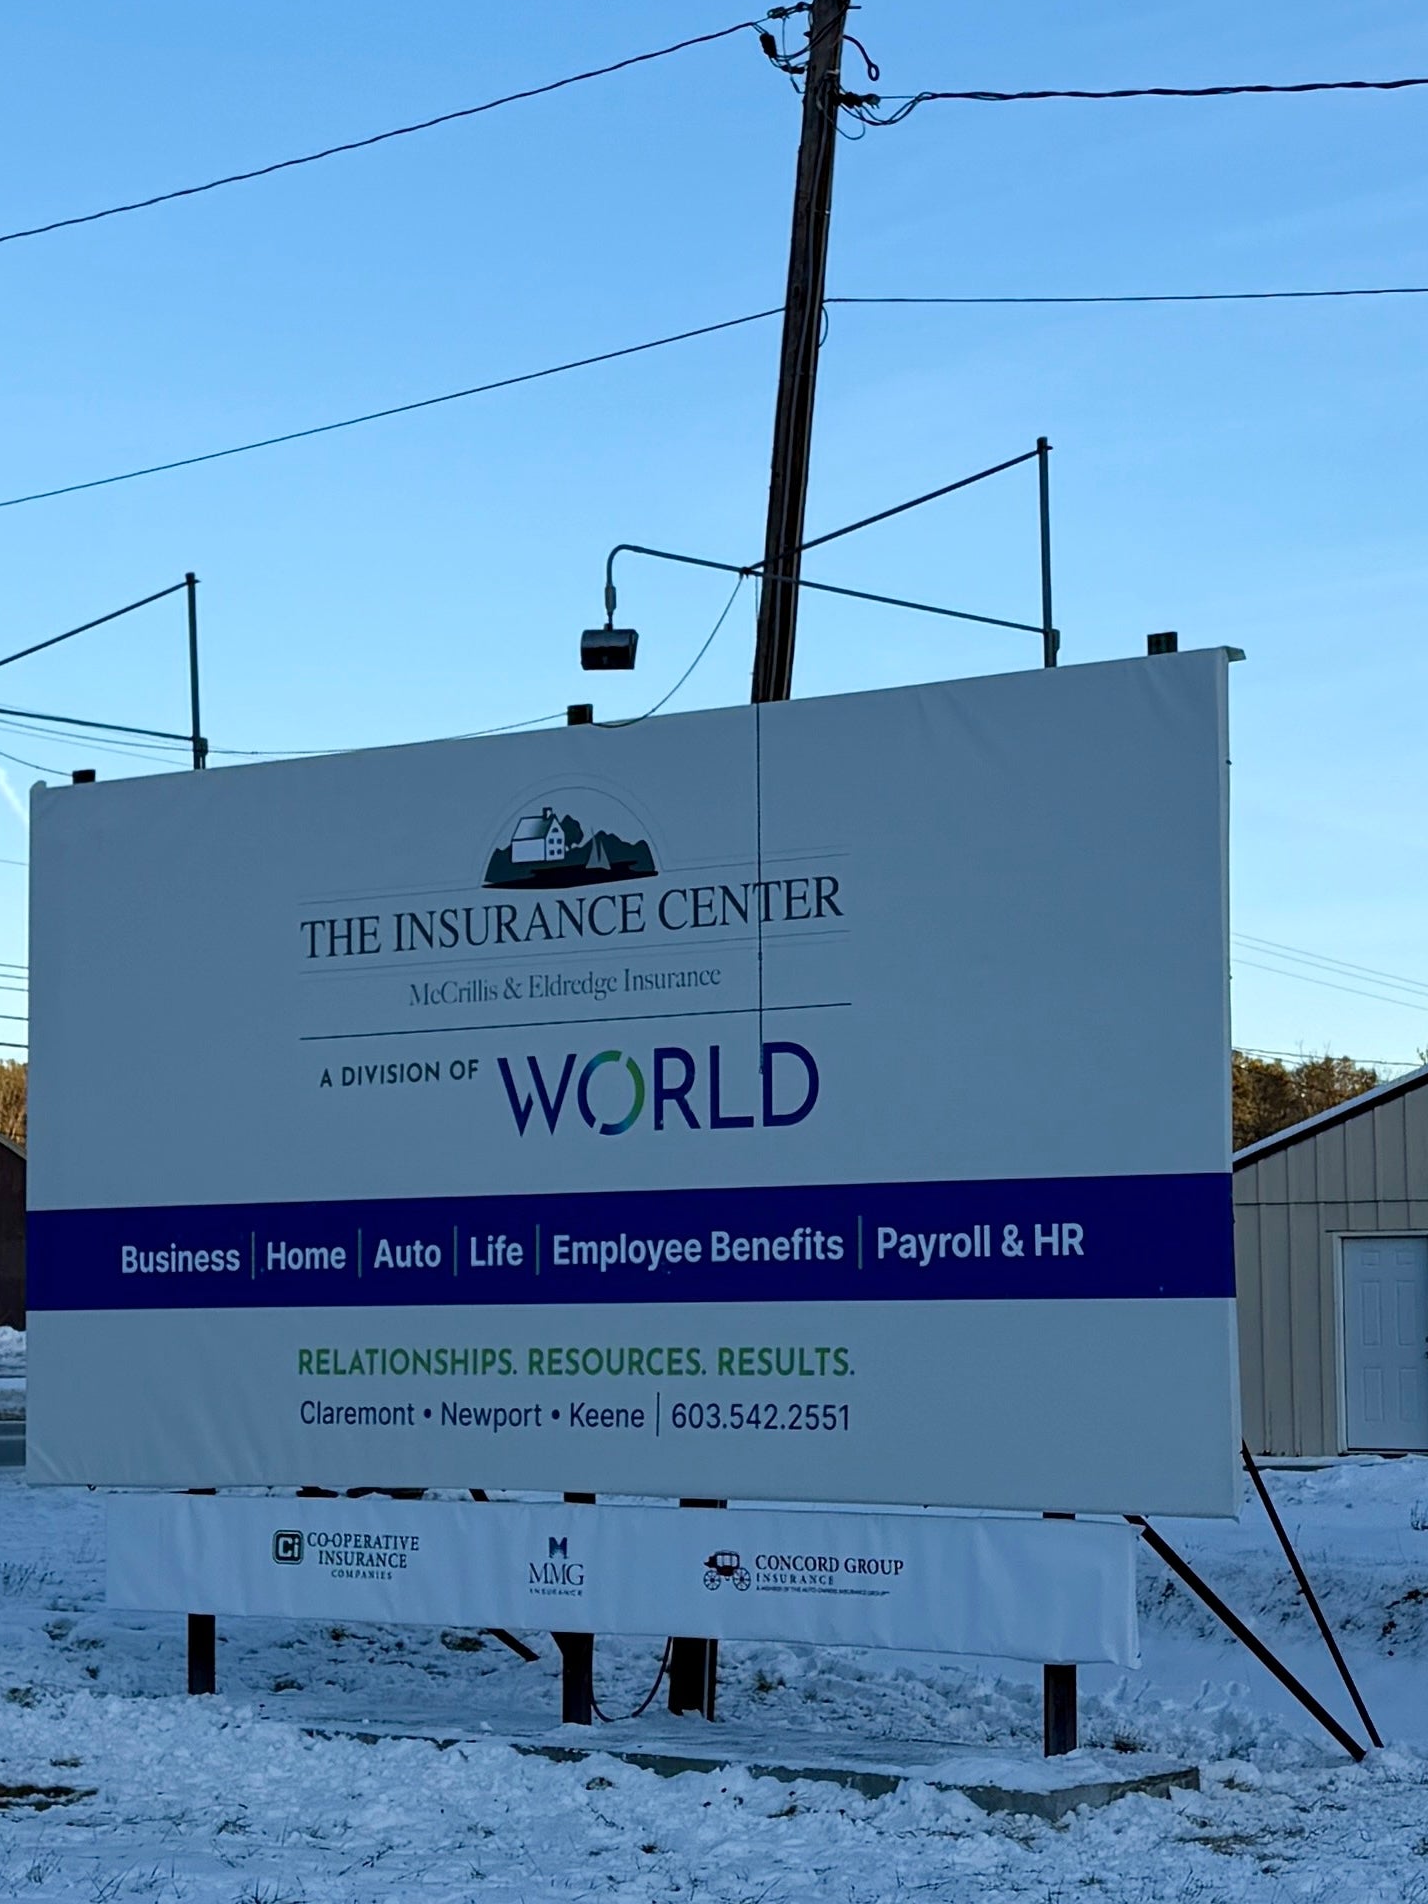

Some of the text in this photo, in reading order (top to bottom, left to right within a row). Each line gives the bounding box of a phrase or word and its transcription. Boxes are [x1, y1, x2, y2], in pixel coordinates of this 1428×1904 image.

[301, 875, 845, 960] THE INSURANCE CENTER
[409, 967, 722, 1007] McCrillis & Eldredge Insurance
[320, 1059, 480, 1088] A DIVISION OF
[497, 1041, 820, 1137] WORLD
[121, 1223, 1085, 1274] Business Home Auto Life Employee Benefits Payroll & HR
[298, 1347, 856, 1377] RELATIONSHIPS. RESOURCES. RESULTS.
[300, 1400, 850, 1433] Claremont Newport Keene 603.542.2551
[307, 1532, 420, 1551] CO-OPERATIVE
[319, 1551, 408, 1569] INSURANCE
[331, 1569, 393, 1580] COMPANIES
[529, 1562, 585, 1586] MMG
[755, 1554, 904, 1576] CONCORD GROUP
[756, 1573, 834, 1586] INSURANCE
